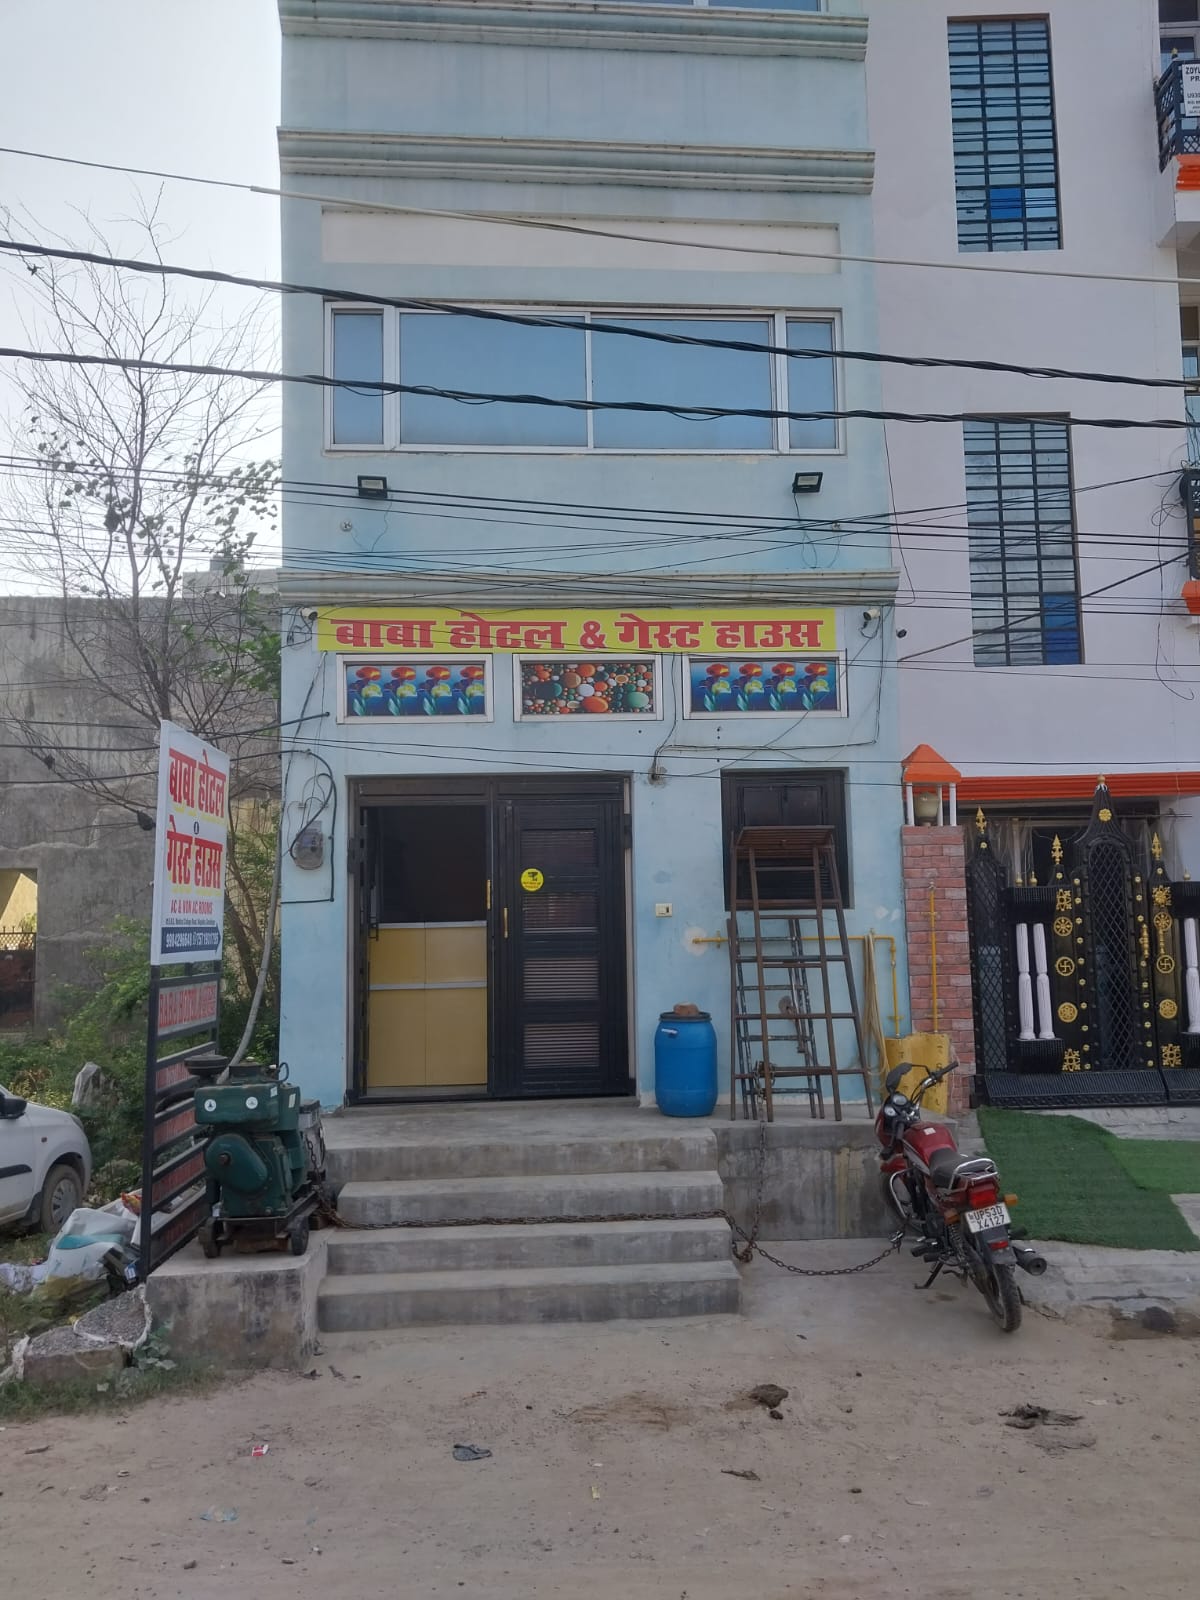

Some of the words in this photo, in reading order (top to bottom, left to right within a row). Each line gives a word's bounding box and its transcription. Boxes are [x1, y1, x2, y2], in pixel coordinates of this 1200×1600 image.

[330, 619, 436, 648] बाबा
[445, 612, 567, 648] होटल
[580, 620, 606, 649] &
[615, 613, 704, 649] गेस्ट
[711, 620, 824, 648] हाउस
[169, 748, 197, 808] बाबा
[198, 749, 226, 818] होटल
[167, 815, 193, 884] गेस्ट
[195, 838, 223, 889] हाउस
[974, 1206, 1003, 1220] UP53D
